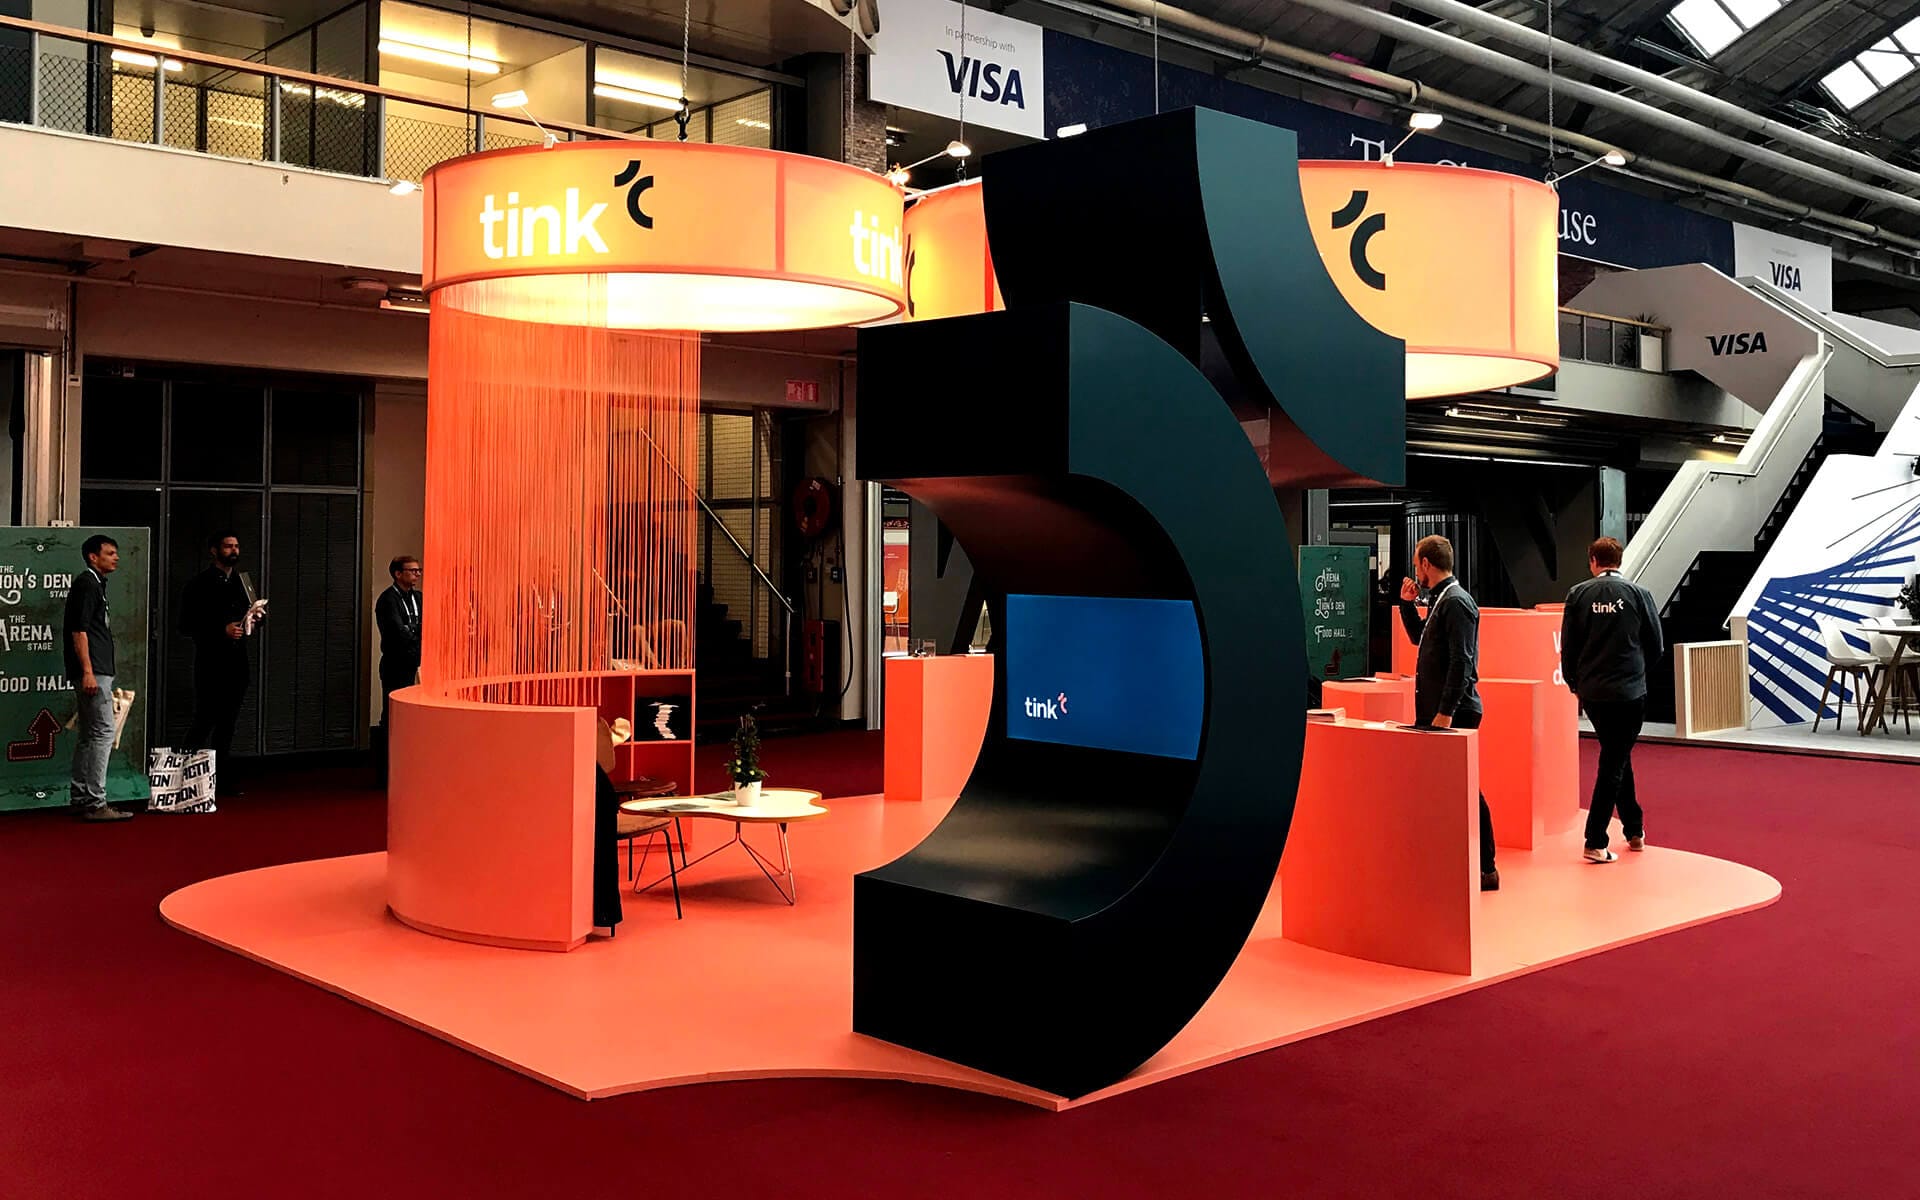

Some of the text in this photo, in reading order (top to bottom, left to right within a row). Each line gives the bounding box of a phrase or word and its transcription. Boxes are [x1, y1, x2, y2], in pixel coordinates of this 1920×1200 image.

[945, 25, 1016, 53] In partnership with
[936, 49, 1025, 110] VISA
[480, 188, 609, 259] tink
[1768, 260, 1801, 292] VISA
[1705, 332, 1767, 356] VISA
[43, 574, 72, 589] DEN
[49, 590, 70, 598] STAG
[1592, 602, 1616, 613] tink
[9, 615, 26, 623] THE
[27, 643, 53, 651] STAGE
[0, 671, 30, 693] OOD
[1024, 697, 1058, 720] tink
